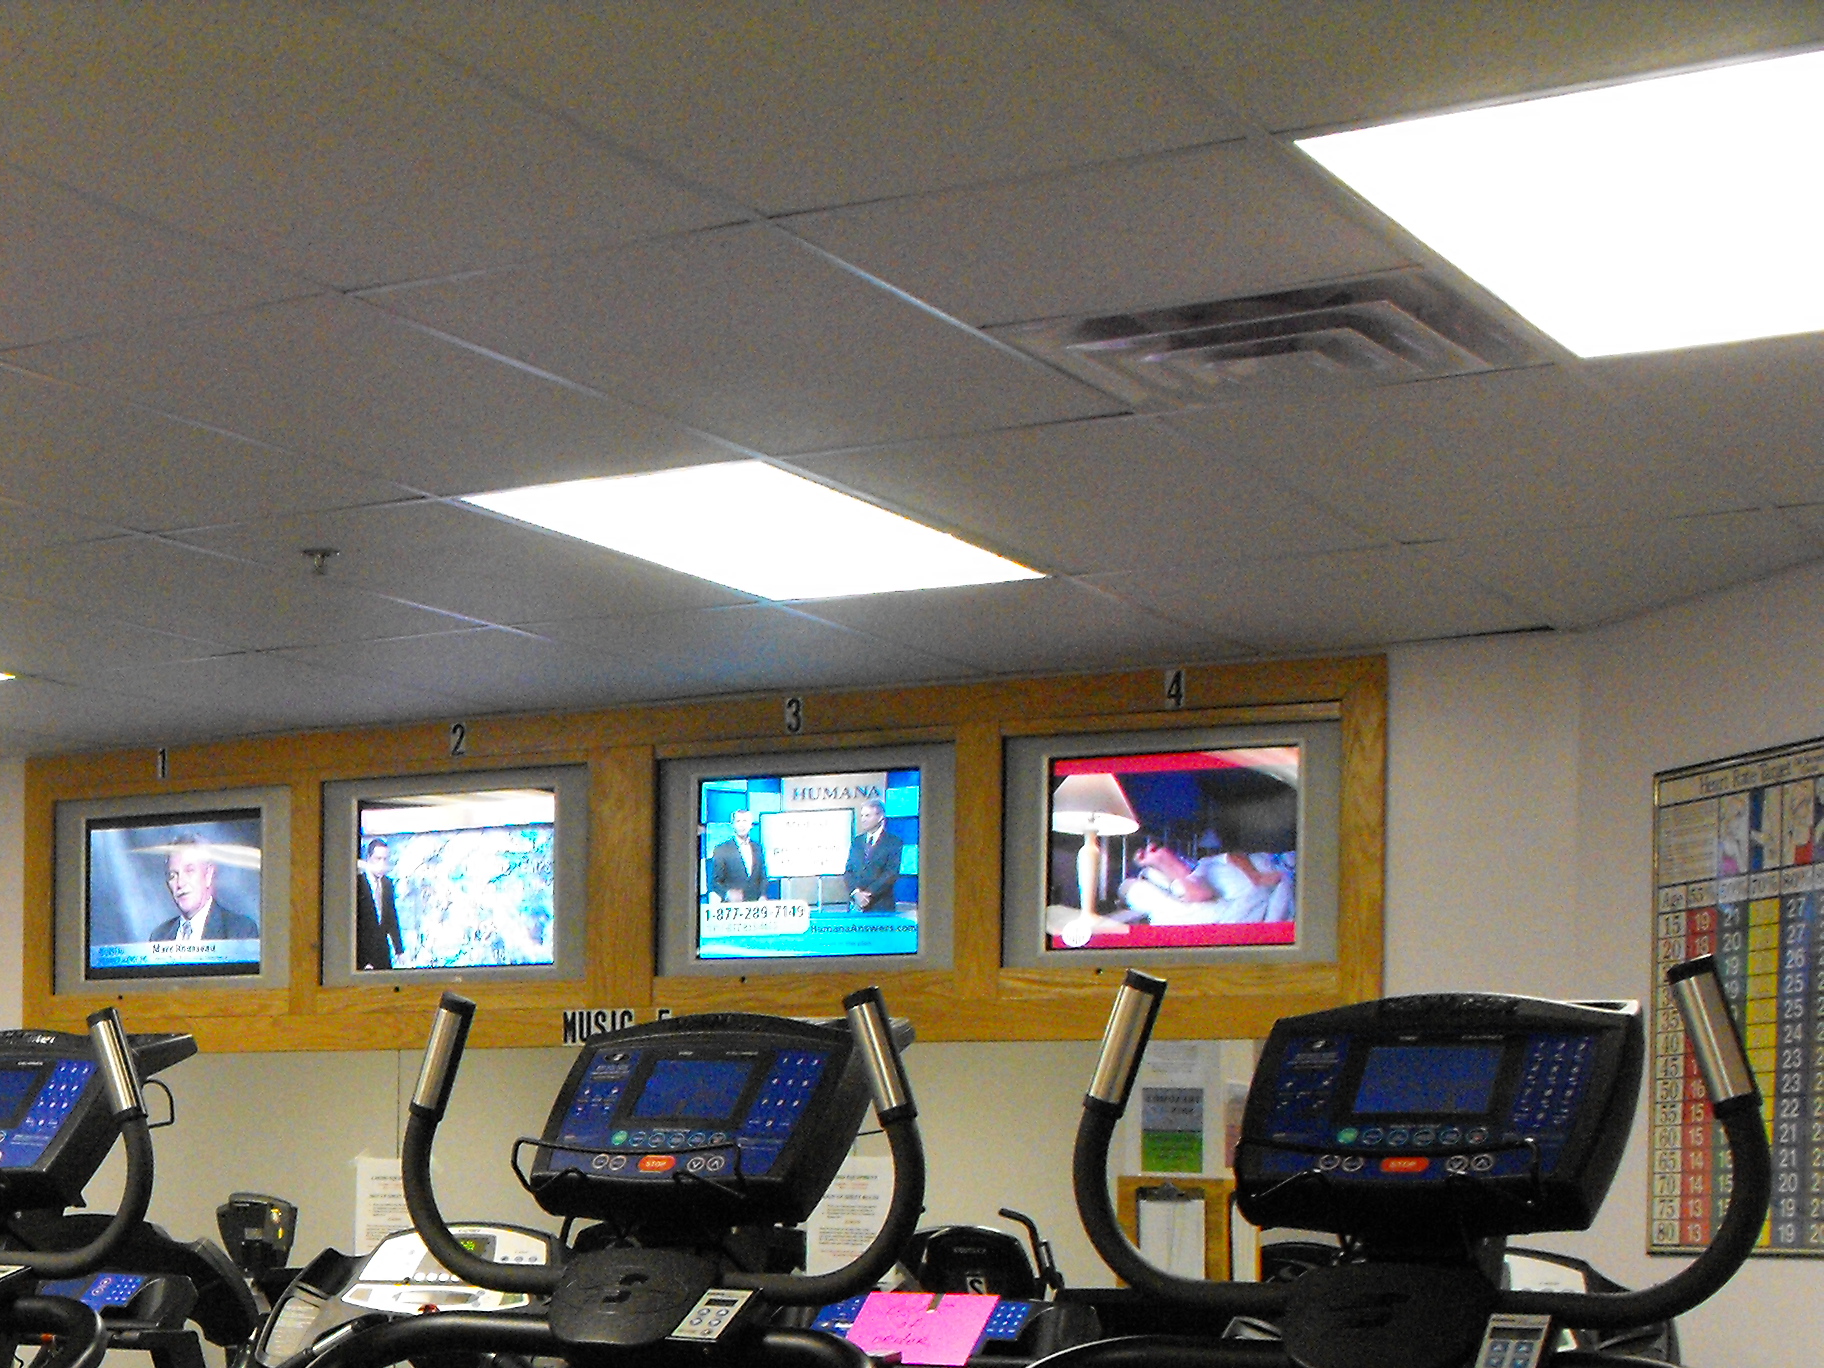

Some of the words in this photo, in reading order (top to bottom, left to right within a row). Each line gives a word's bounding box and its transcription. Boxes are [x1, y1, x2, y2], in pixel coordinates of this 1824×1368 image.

[1166, 672, 1183, 708] 4
[786, 699, 802, 733] 3
[450, 725, 466, 757] 2
[157, 748, 167, 779] 1
[792, 785, 881, 802] HUMANA
[1787, 897, 1807, 918] 27
[810, 923, 918, 934] HumanaAnswers.com
[1723, 931, 1742, 951] 20
[1786, 923, 1807, 944] 27
[1785, 948, 1806, 970] 26
[1784, 973, 1804, 994] 25
[1784, 999, 1804, 1019] 25
[562, 1009, 634, 1045] MUSIC
[1783, 1023, 1803, 1044] 24
[1782, 1049, 1802, 1069] 23
[1782, 1073, 1801, 1093] 23
[1690, 1102, 1704, 1121] 15
[1780, 1098, 1800, 1118] 22
[1689, 1126, 1704, 1146] 15
[1779, 1123, 1796, 1143] 21
[645, 1160, 668, 1168] STOP
[1388, 1160, 1418, 1169] STOP
[1779, 1148, 1796, 1168] 21
[1778, 1173, 1798, 1192] 20
[1780, 1198, 1796, 1218] 19
[1778, 1223, 1795, 1243] 19
